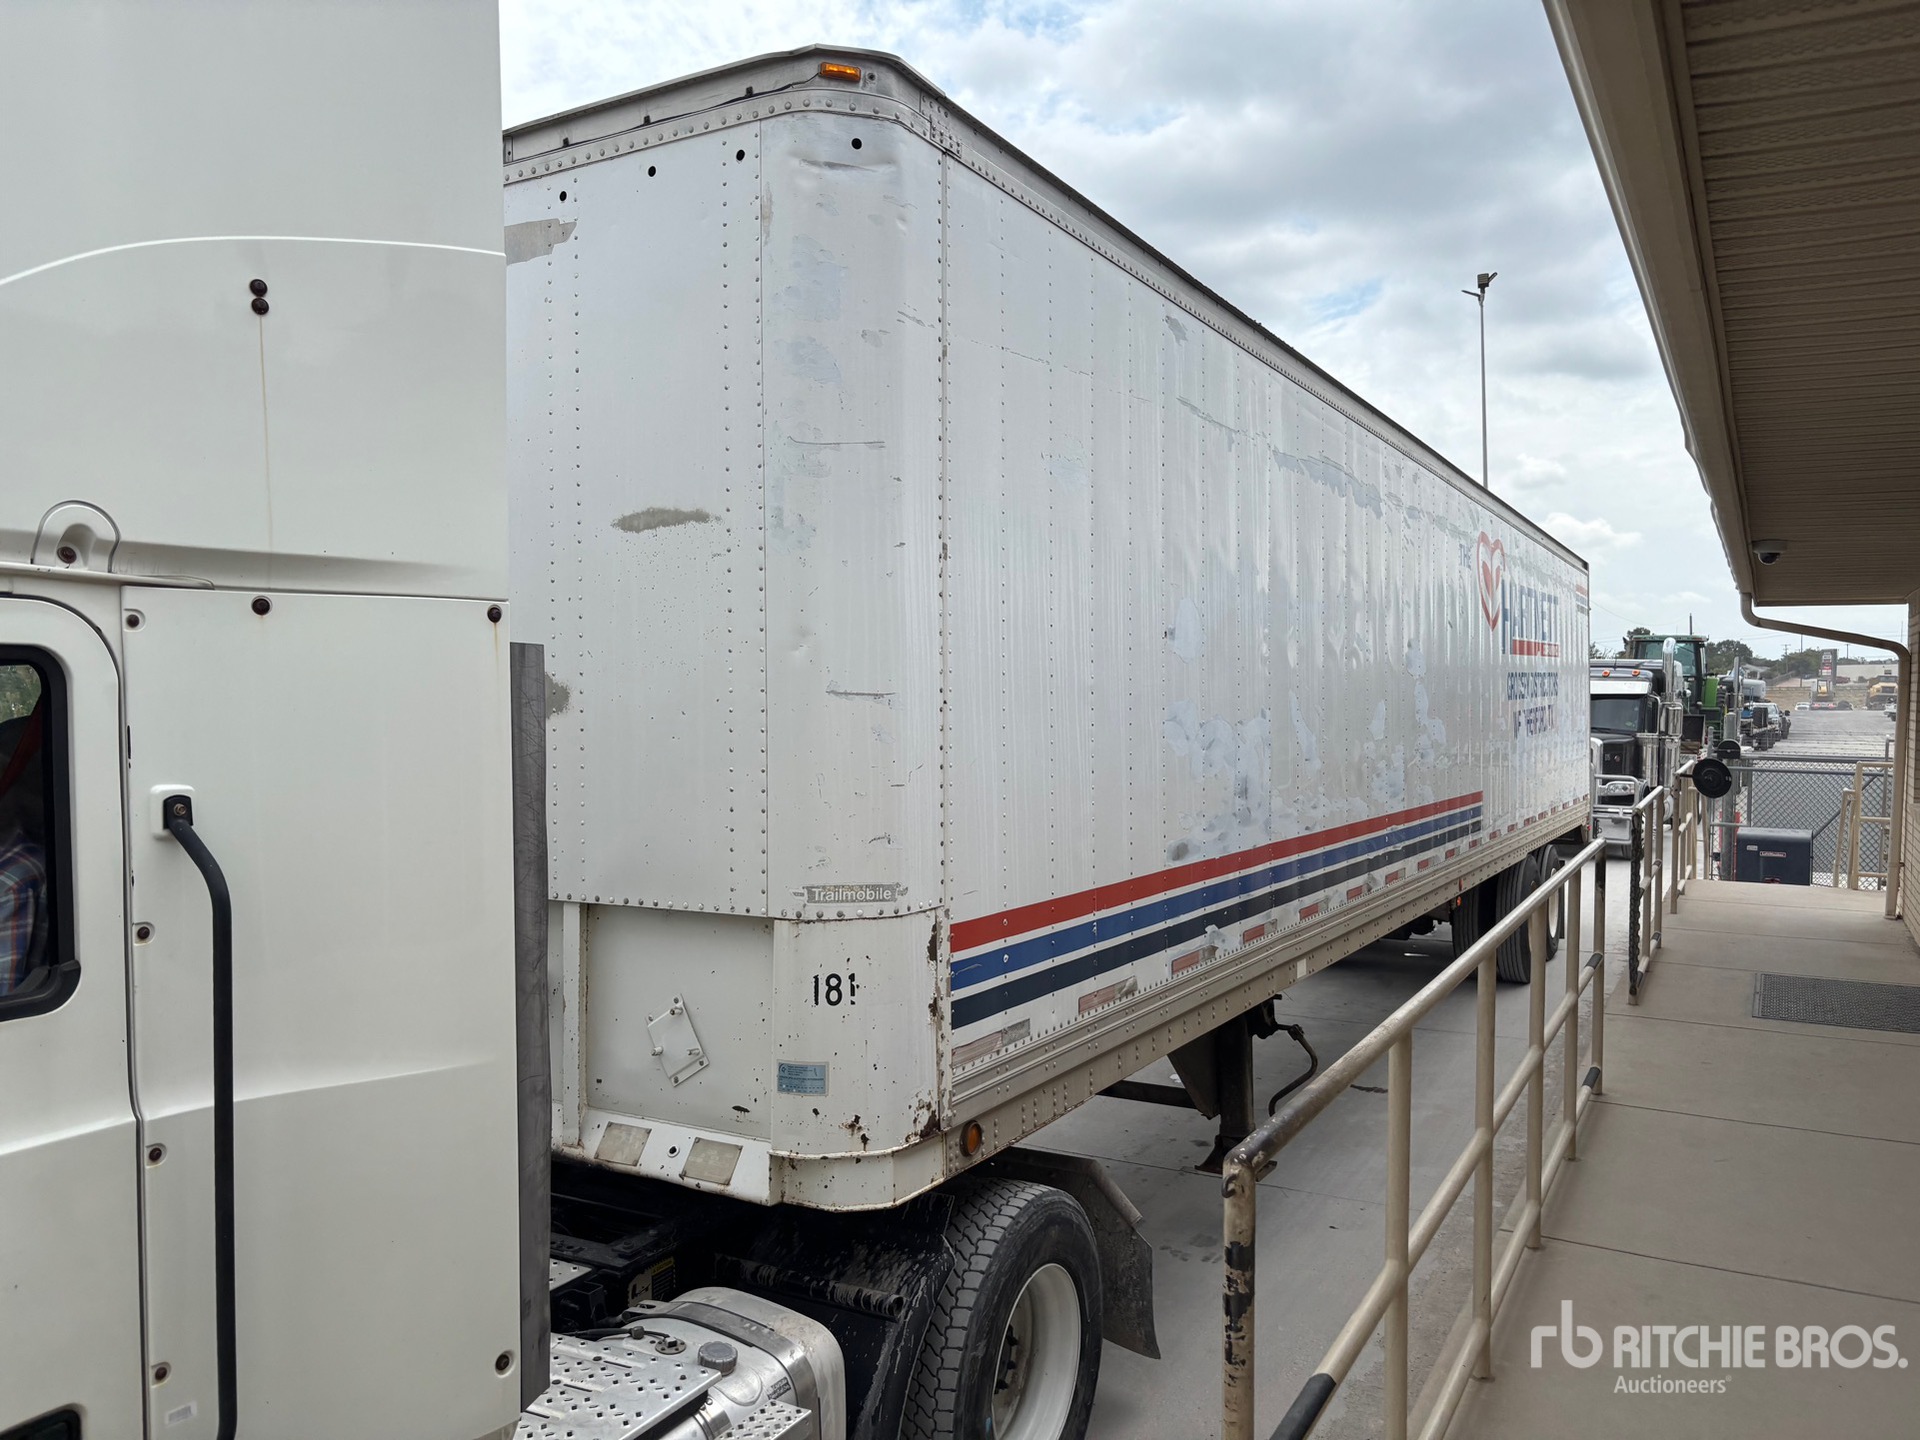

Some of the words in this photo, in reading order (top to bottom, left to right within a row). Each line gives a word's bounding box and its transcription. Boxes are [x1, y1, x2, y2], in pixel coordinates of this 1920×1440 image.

[1459, 543, 1471, 570] THE
[1501, 579, 1558, 655] HARTNETT
[812, 887, 892, 901] Trailmobile
[813, 973, 855, 1006] 181
